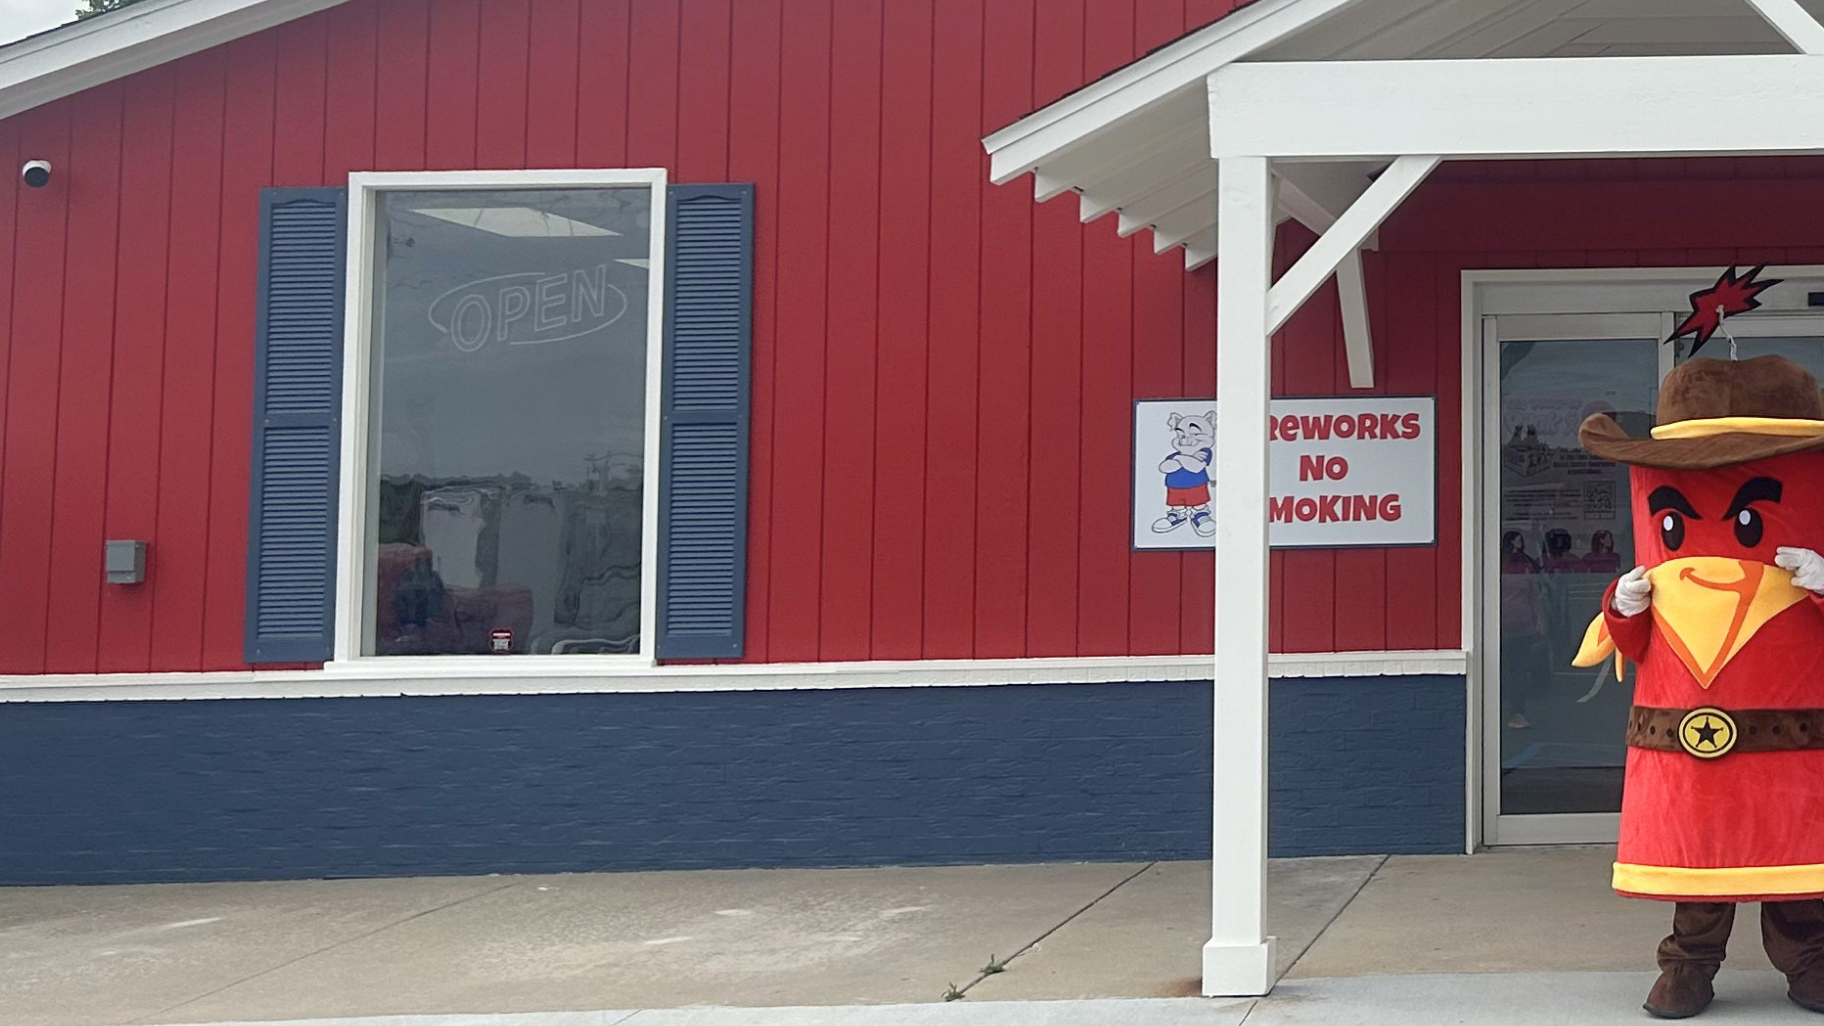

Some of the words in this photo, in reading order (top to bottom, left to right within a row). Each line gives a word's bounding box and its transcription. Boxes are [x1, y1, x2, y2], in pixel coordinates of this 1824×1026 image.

[450, 264, 607, 353] OPEN
[1299, 454, 1349, 482] NO
[1269, 493, 1402, 523] MOKING
